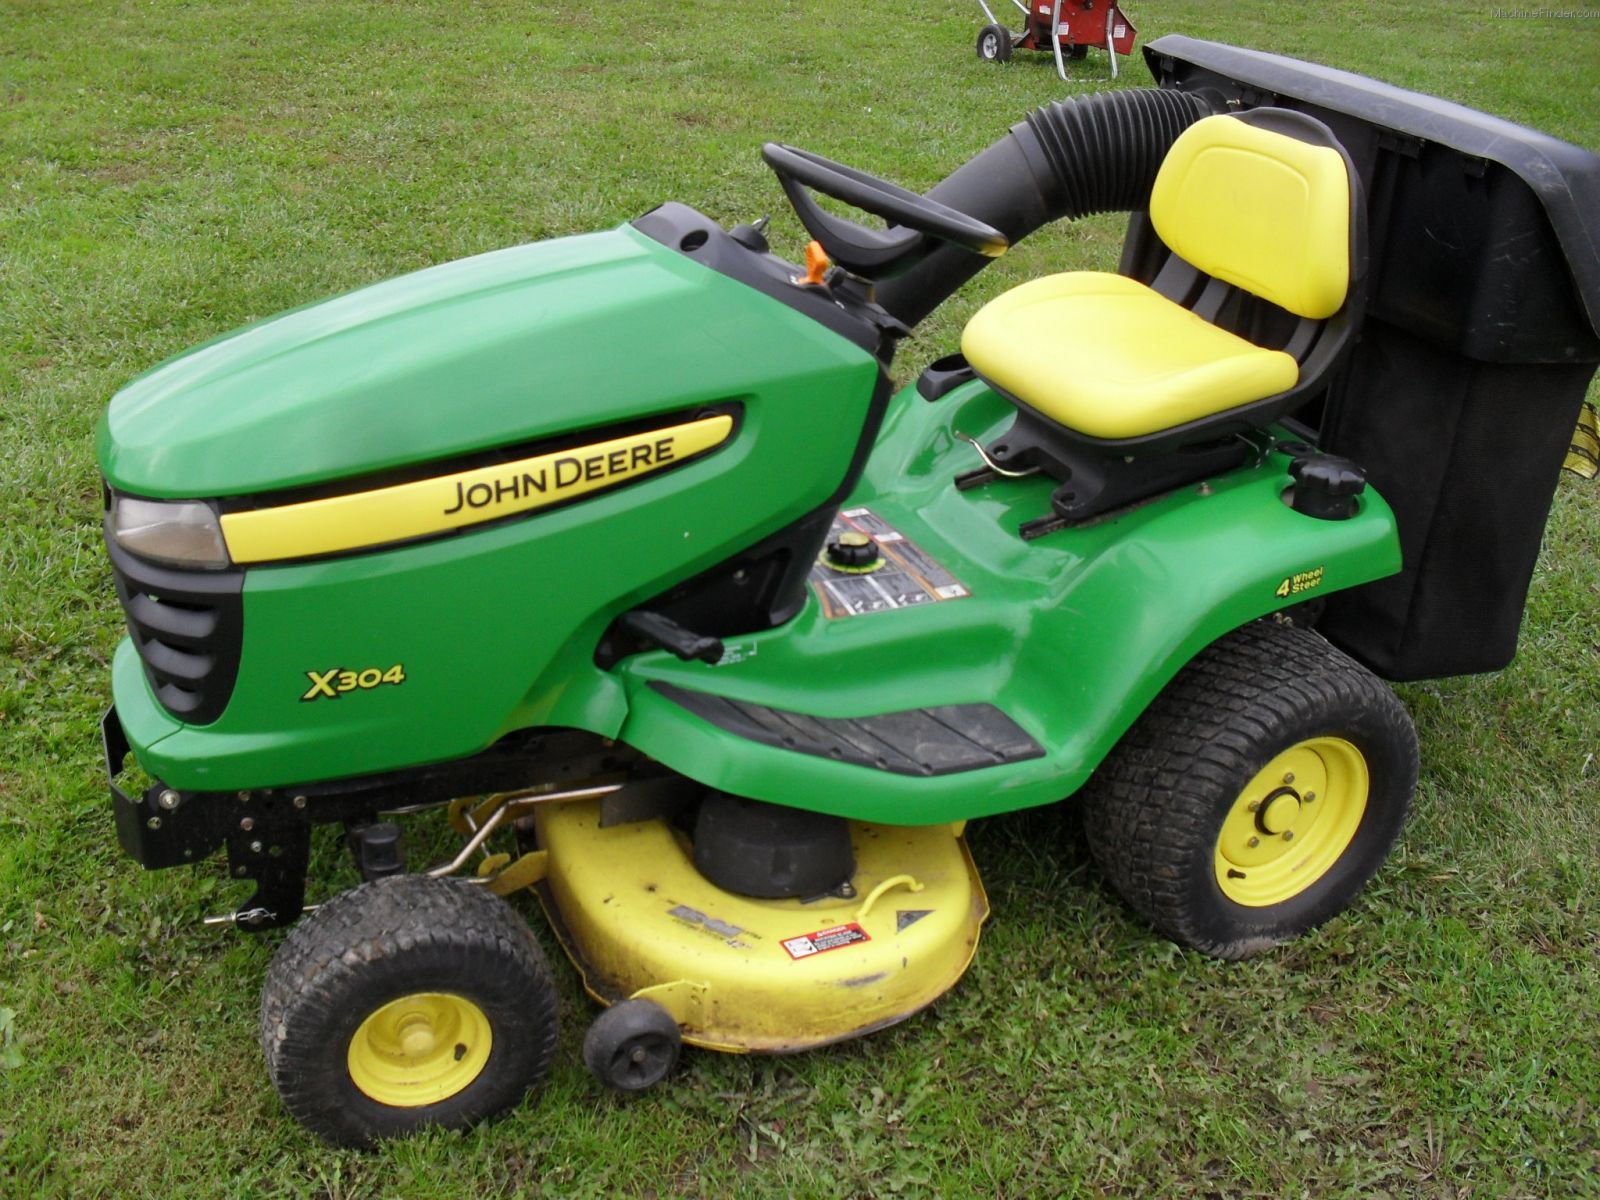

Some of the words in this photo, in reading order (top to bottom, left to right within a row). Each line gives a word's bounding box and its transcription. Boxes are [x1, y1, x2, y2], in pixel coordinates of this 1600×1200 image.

[444, 470, 547, 515] JOHN
[553, 438, 675, 490] DEERE
[1293, 566, 1323, 584] Wheel
[1276, 578, 1290, 597] 4
[1292, 577, 1321, 594] Steer
[301, 664, 405, 701] X304
